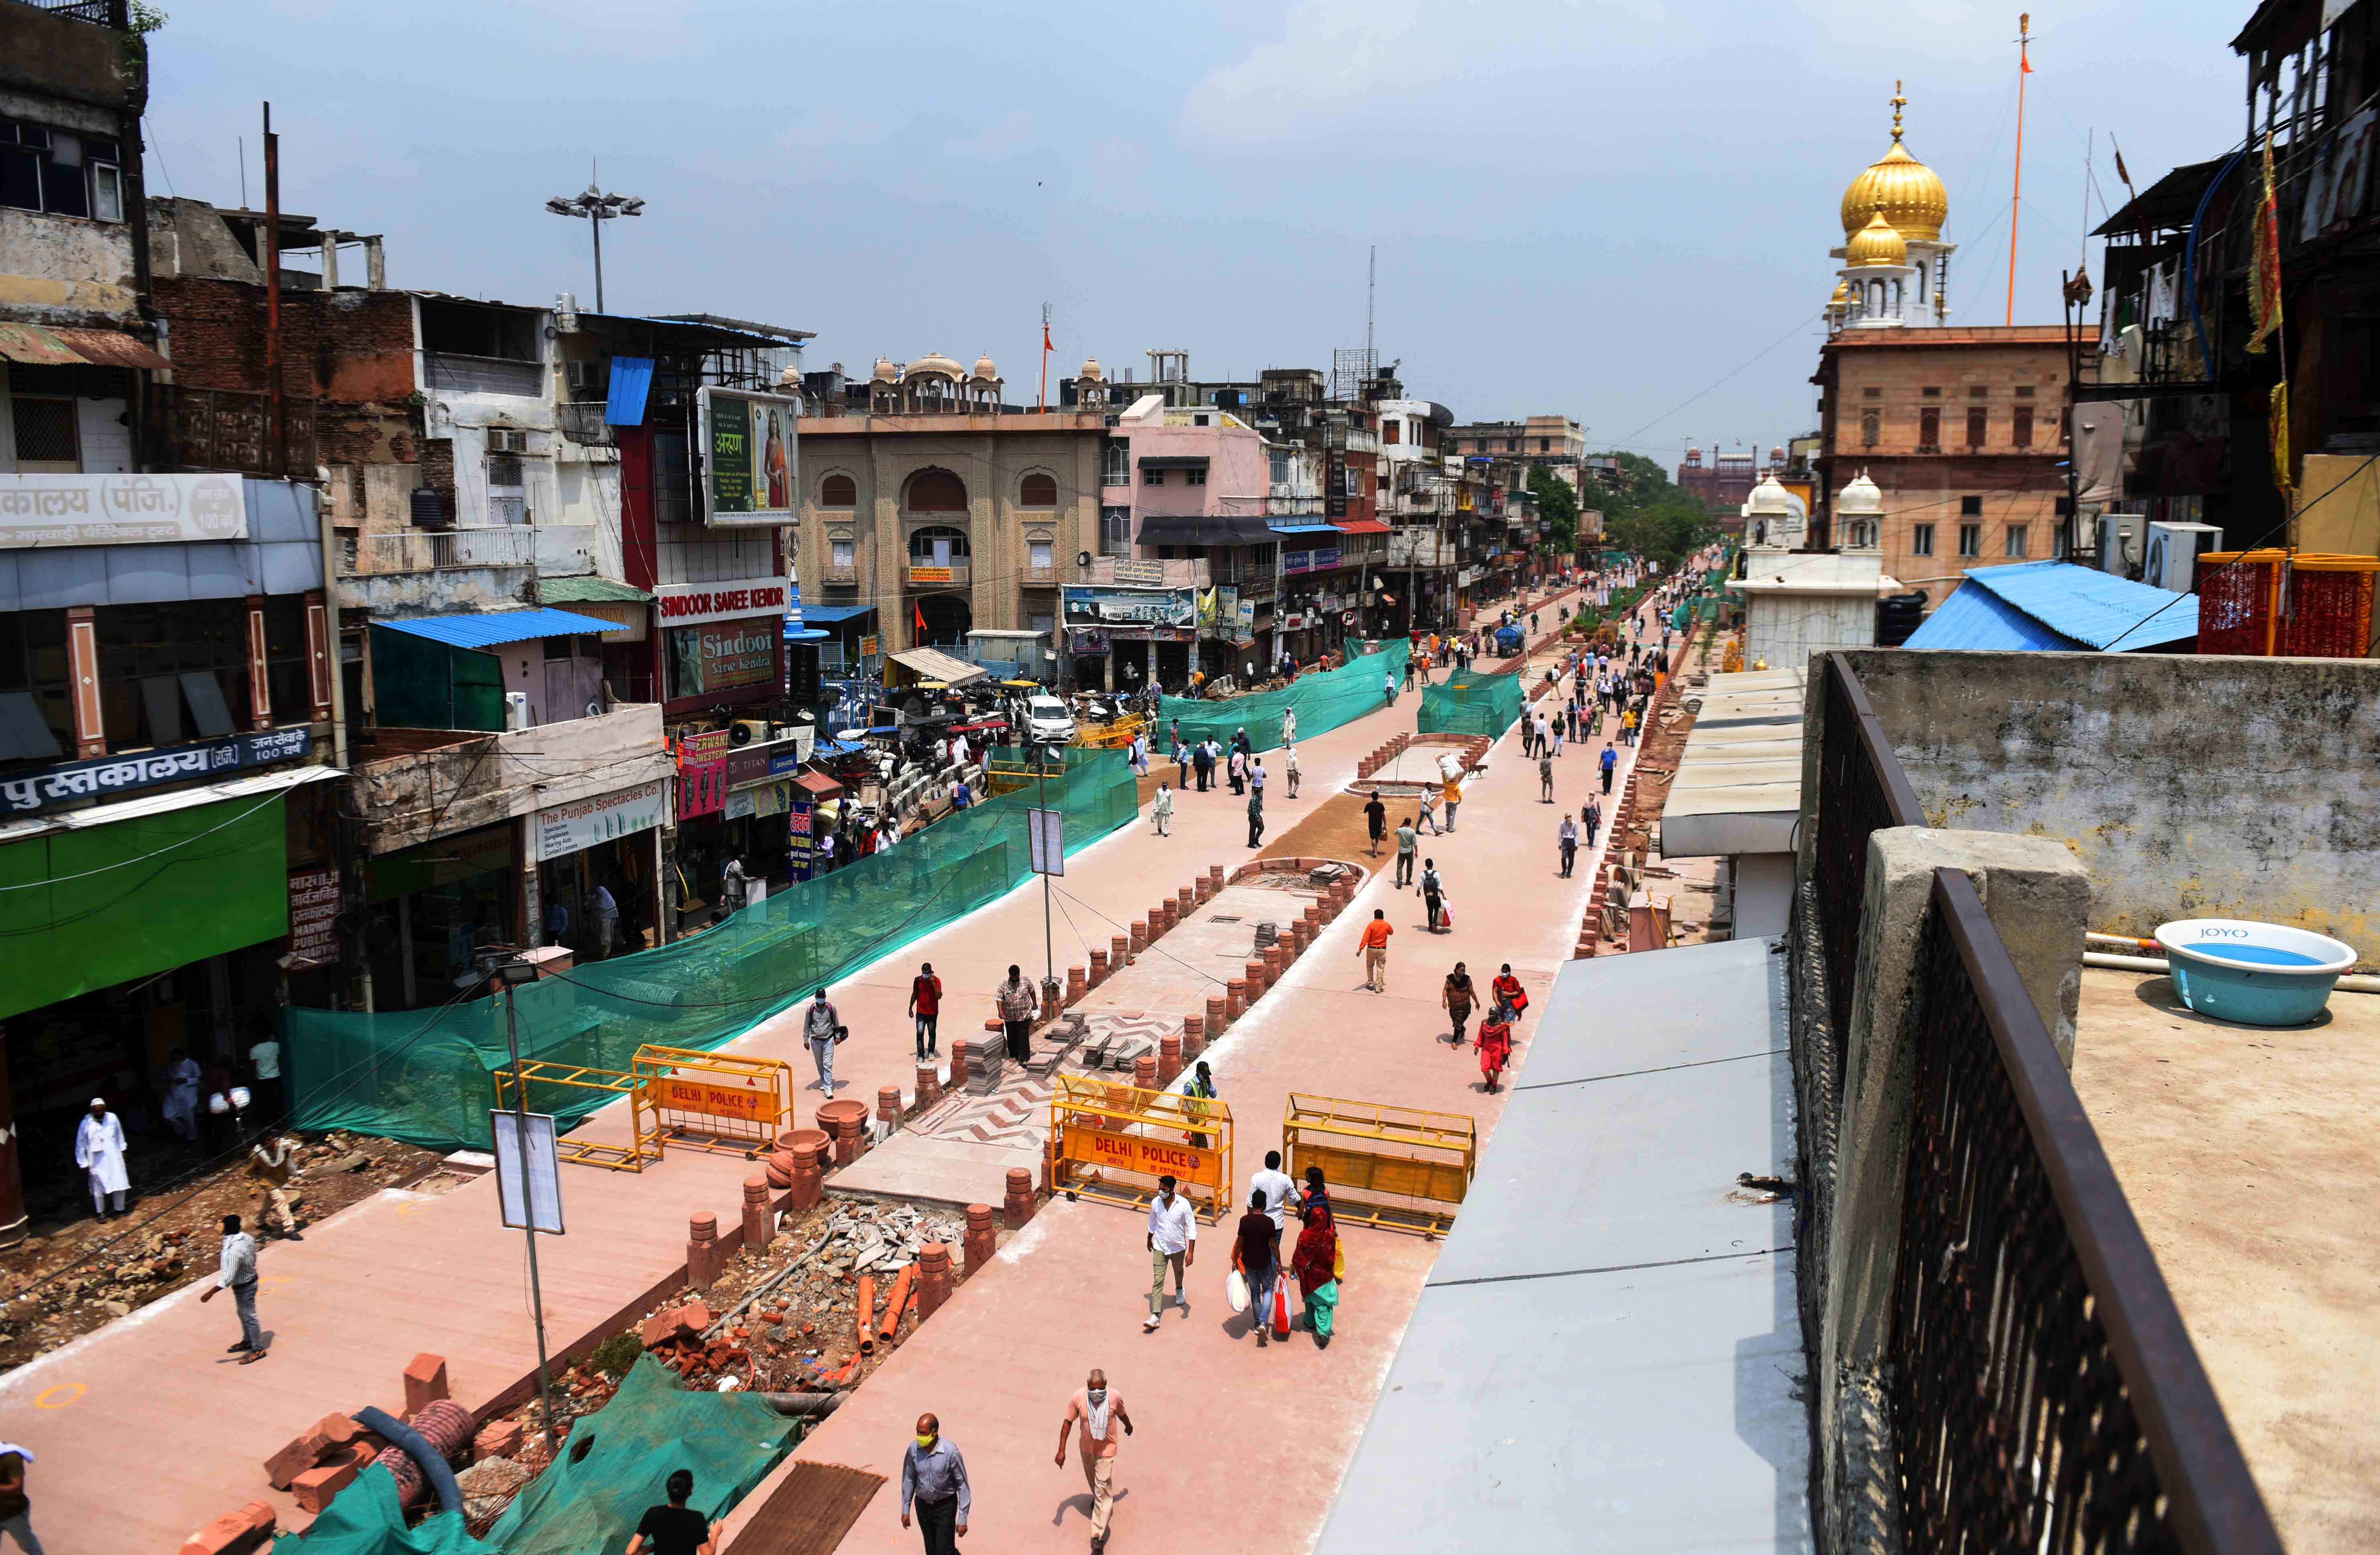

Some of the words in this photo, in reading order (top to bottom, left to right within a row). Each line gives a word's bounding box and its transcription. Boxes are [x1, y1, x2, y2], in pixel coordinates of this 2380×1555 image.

[0, 488, 90, 516] कालय
[100, 475, 182, 519] (पंजि.)
[197, 513, 218, 529] 100
[661, 592, 712, 617] SINDOOR
[714, 589, 749, 613] SAREE
[750, 587, 784, 607] KENDR
[703, 630, 773, 659] Sindoor
[712, 660, 736, 675] Saree
[738, 656, 771, 670] Kendra
[250, 736, 272, 749] जन
[273, 731, 296, 746] सेवा
[295, 729, 306, 742] के
[696, 734, 729, 752] ERWANI
[255, 747, 280, 760] 100
[282, 742, 302, 756] वर्ष
[743, 758, 766, 770] TITAN
[1, 748, 209, 810] पुस्तकालय
[540, 812, 559, 826] The
[561, 803, 593, 820] Punjab
[596, 789, 643, 812] Spectacles
[645, 785, 659, 797] Co.
[544, 823, 568, 834] Spectacles
[790, 804, 812, 835] शेरवानी
[544, 830, 569, 842] Sunglasses
[545, 838, 562, 849] Hearing
[545, 847, 562, 857] Contact
[562, 843, 578, 852] Lenses
[291, 886, 340, 907] सार्वजनिक
[293, 931, 332, 950] PUBLIC
[2200, 927, 2248, 938] JOYO
[672, 1085, 702, 1102] DELHI
[709, 1091, 744, 1108] POLICE
[1095, 1136, 1132, 1157] DELHI
[1142, 1146, 1187, 1167] POLICE
[1106, 1156, 1124, 1166] NORTH
